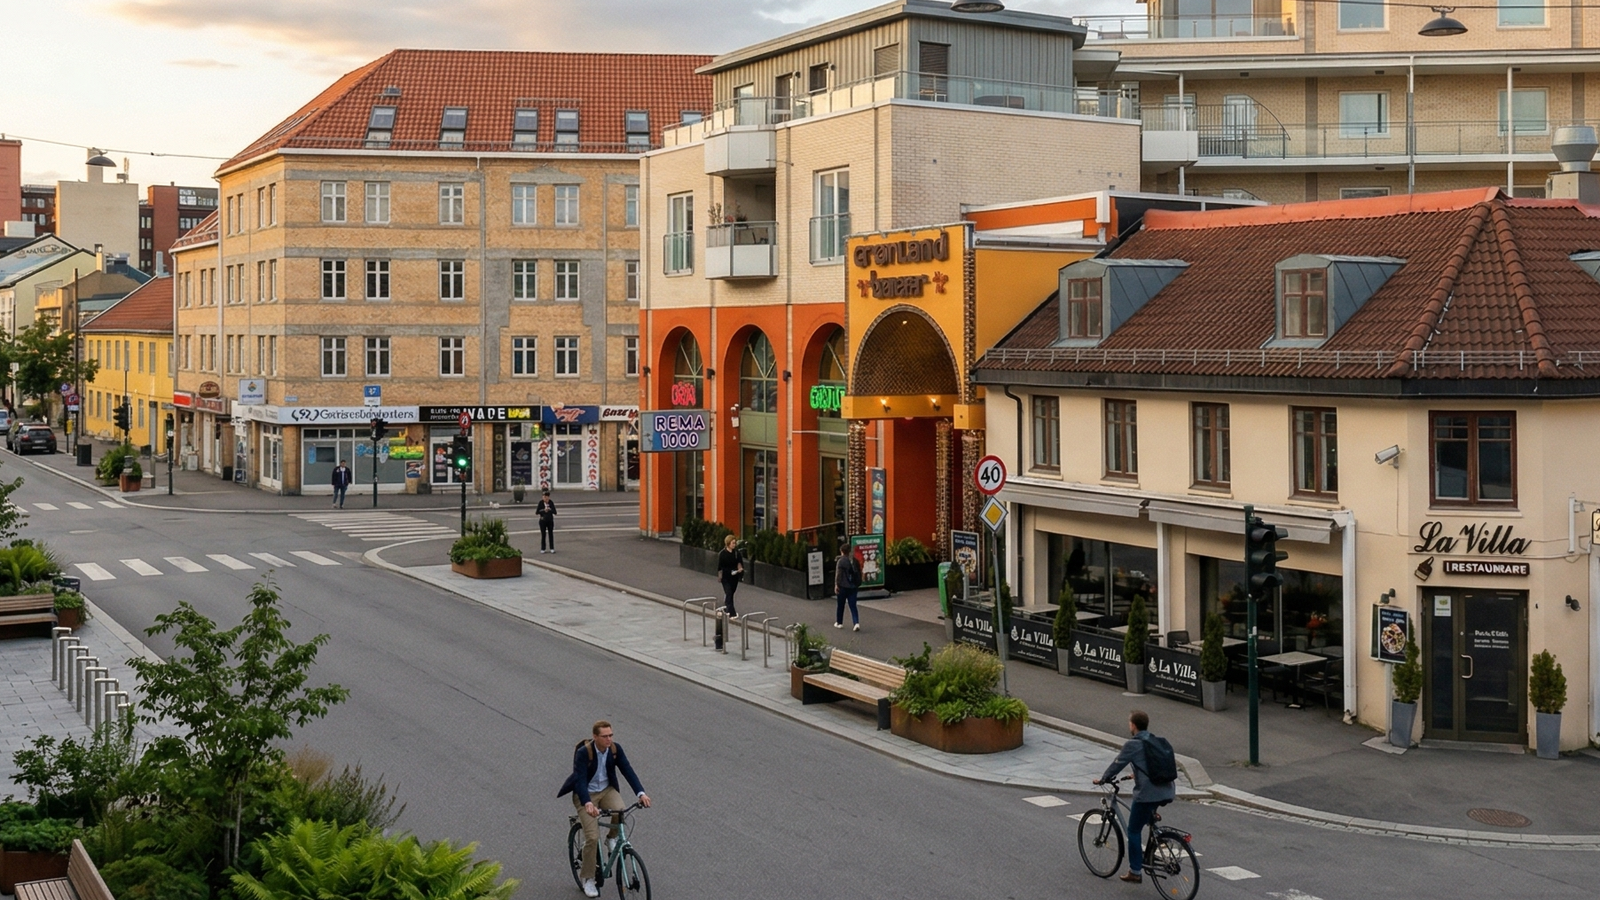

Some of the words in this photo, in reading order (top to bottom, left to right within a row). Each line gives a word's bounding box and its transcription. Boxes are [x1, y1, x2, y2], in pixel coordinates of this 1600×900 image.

[655, 414, 706, 432] REMA
[660, 431, 699, 448] 1000
[980, 464, 1001, 484] 40
[1414, 521, 1459, 553] La
[1459, 521, 1532, 555] Villa
[964, 615, 974, 629] La
[1020, 628, 1032, 642] La
[1033, 631, 1054, 647] Villa
[1083, 643, 1097, 657] La
[1099, 646, 1122, 662] Villa
[1158, 659, 1171, 673] La
[1172, 662, 1197, 680] Villa
